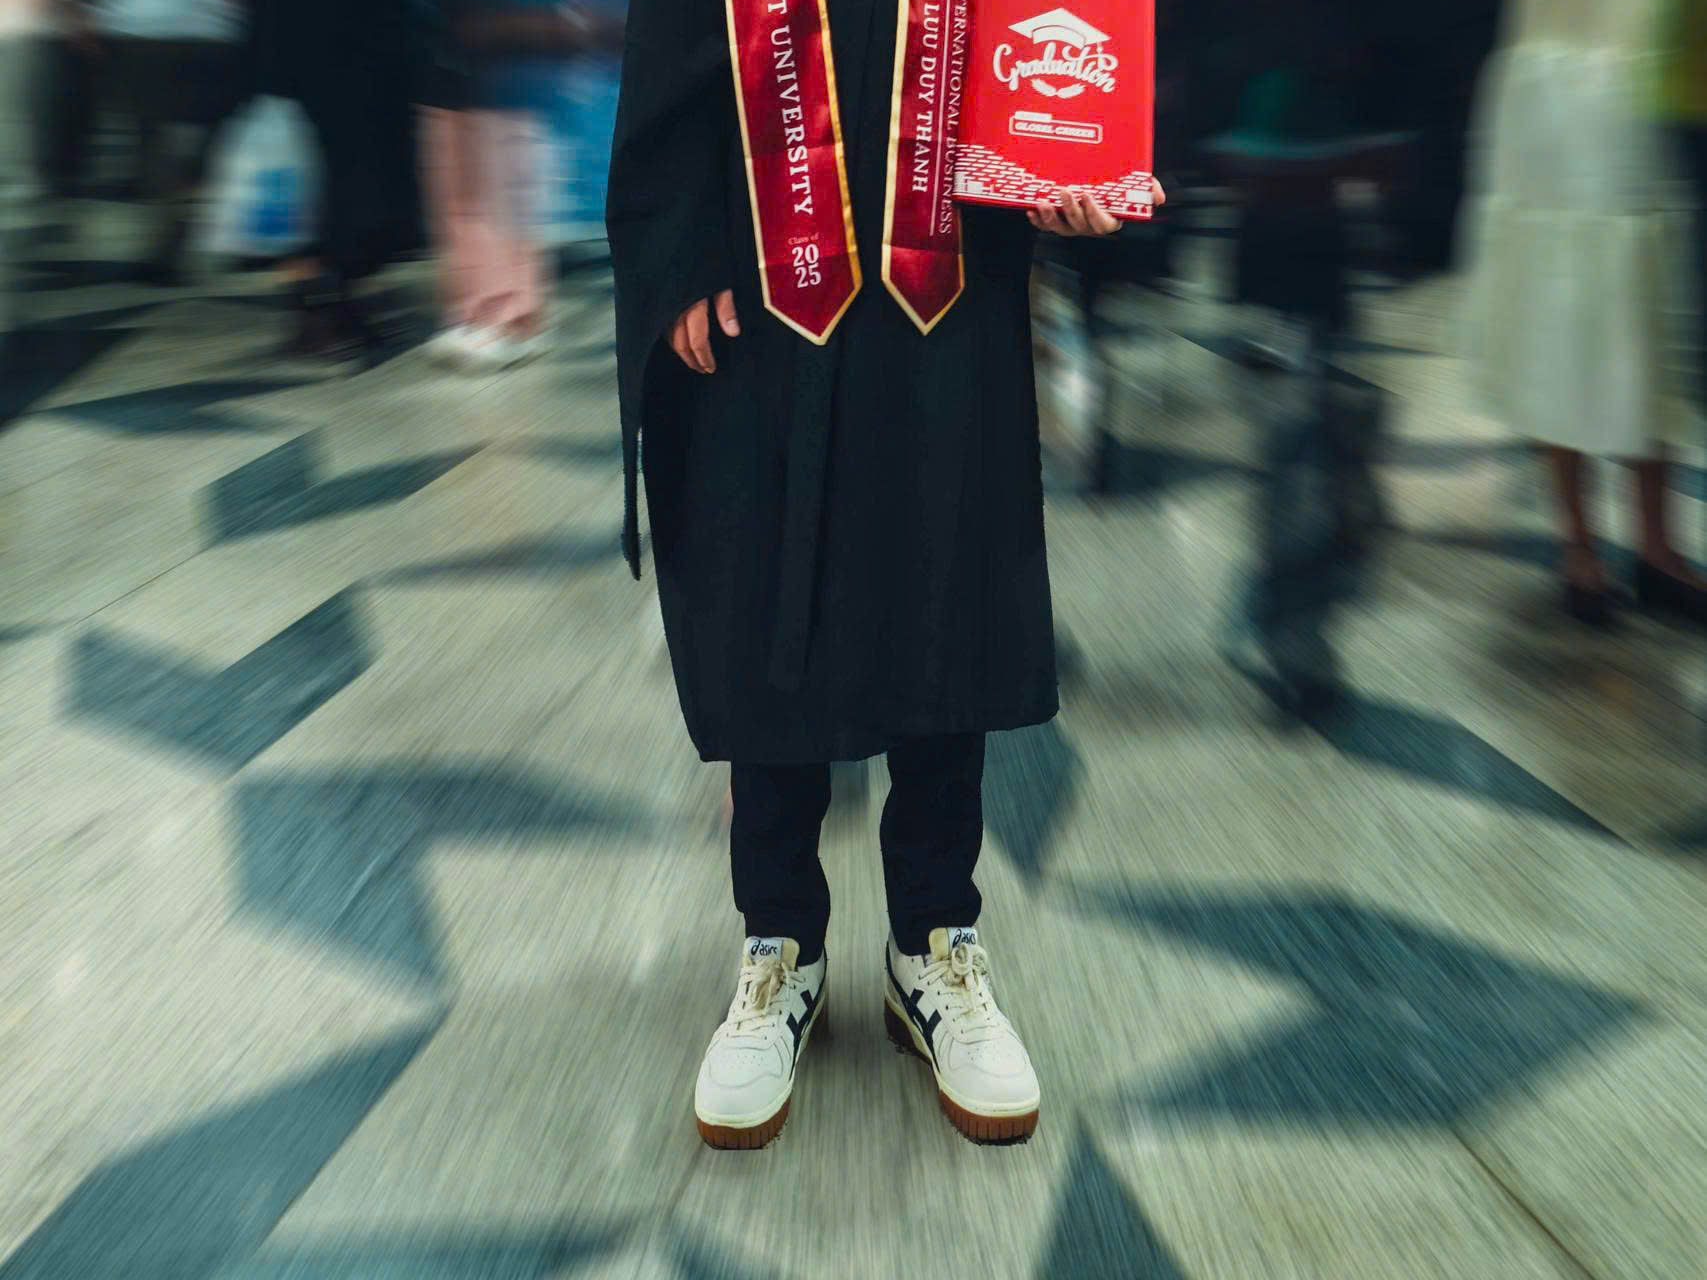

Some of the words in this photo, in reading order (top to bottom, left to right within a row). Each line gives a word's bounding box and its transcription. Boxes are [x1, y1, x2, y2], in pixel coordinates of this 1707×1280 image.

[922, 2, 940, 50] LUU
[918, 55, 937, 105] DUY
[993, 41, 1119, 93] Graduation
[770, 24, 814, 216] UNIVERSITY
[912, 110, 933, 193] THANH
[792, 243, 820, 267] 20
[795, 262, 822, 289] 25
